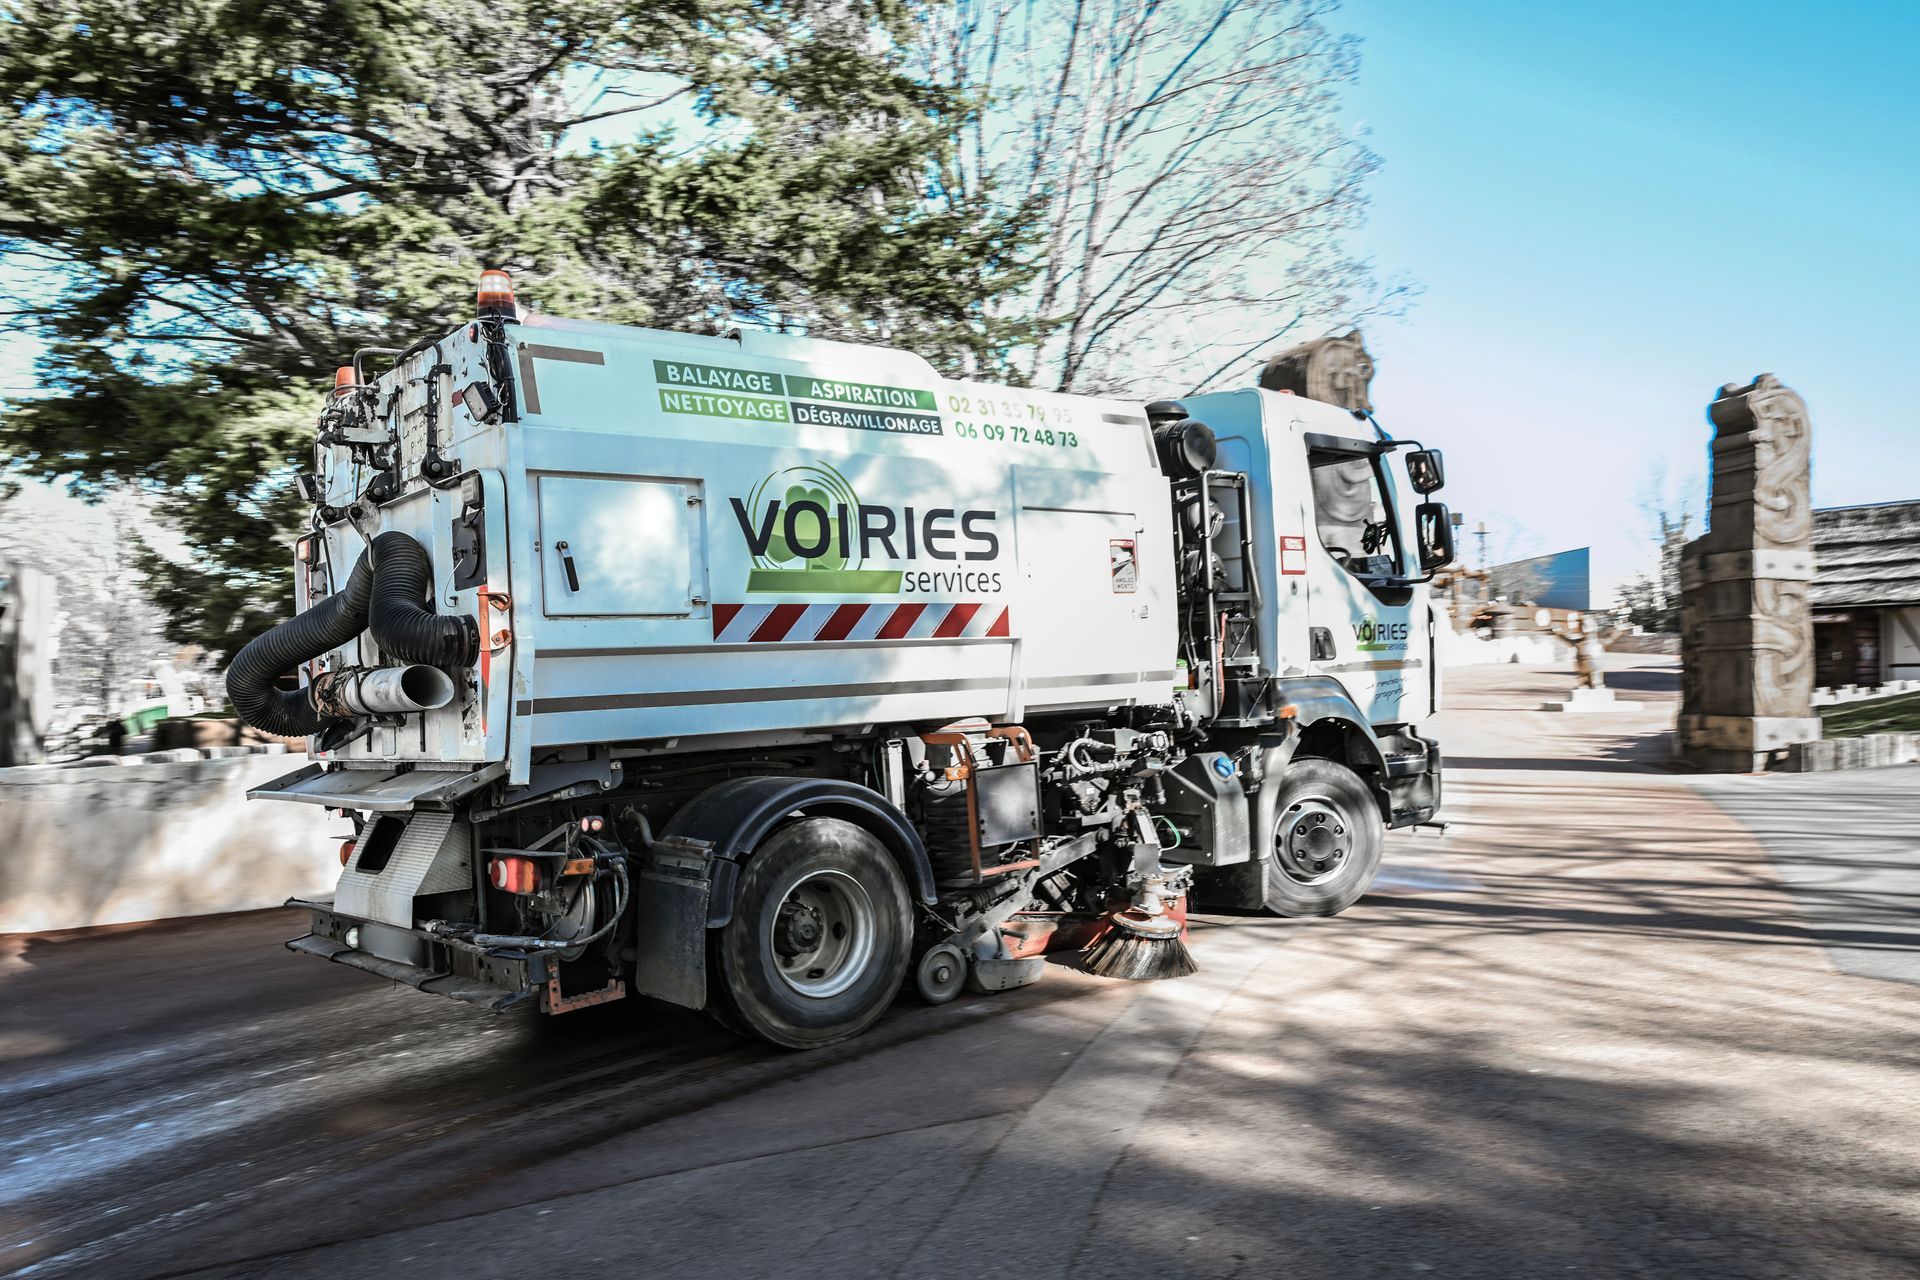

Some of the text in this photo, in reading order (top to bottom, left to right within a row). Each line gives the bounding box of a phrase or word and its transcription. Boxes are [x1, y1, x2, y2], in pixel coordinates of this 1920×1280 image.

[666, 364, 773, 392] BALAYAGE
[663, 392, 785, 420] NETTOYAGE
[810, 381, 918, 407] ASPIRATION
[796, 405, 940, 434] DÉGRAVILLONAGE
[948, 395, 972, 414] 02
[977, 399, 996, 416] 31
[1026, 404, 1046, 422] 79
[955, 421, 1078, 448] 06 09 72 48 73
[728, 497, 1000, 561] VOIRIES
[905, 564, 1002, 594] services
[1352, 623, 1408, 641] VOIRIES
